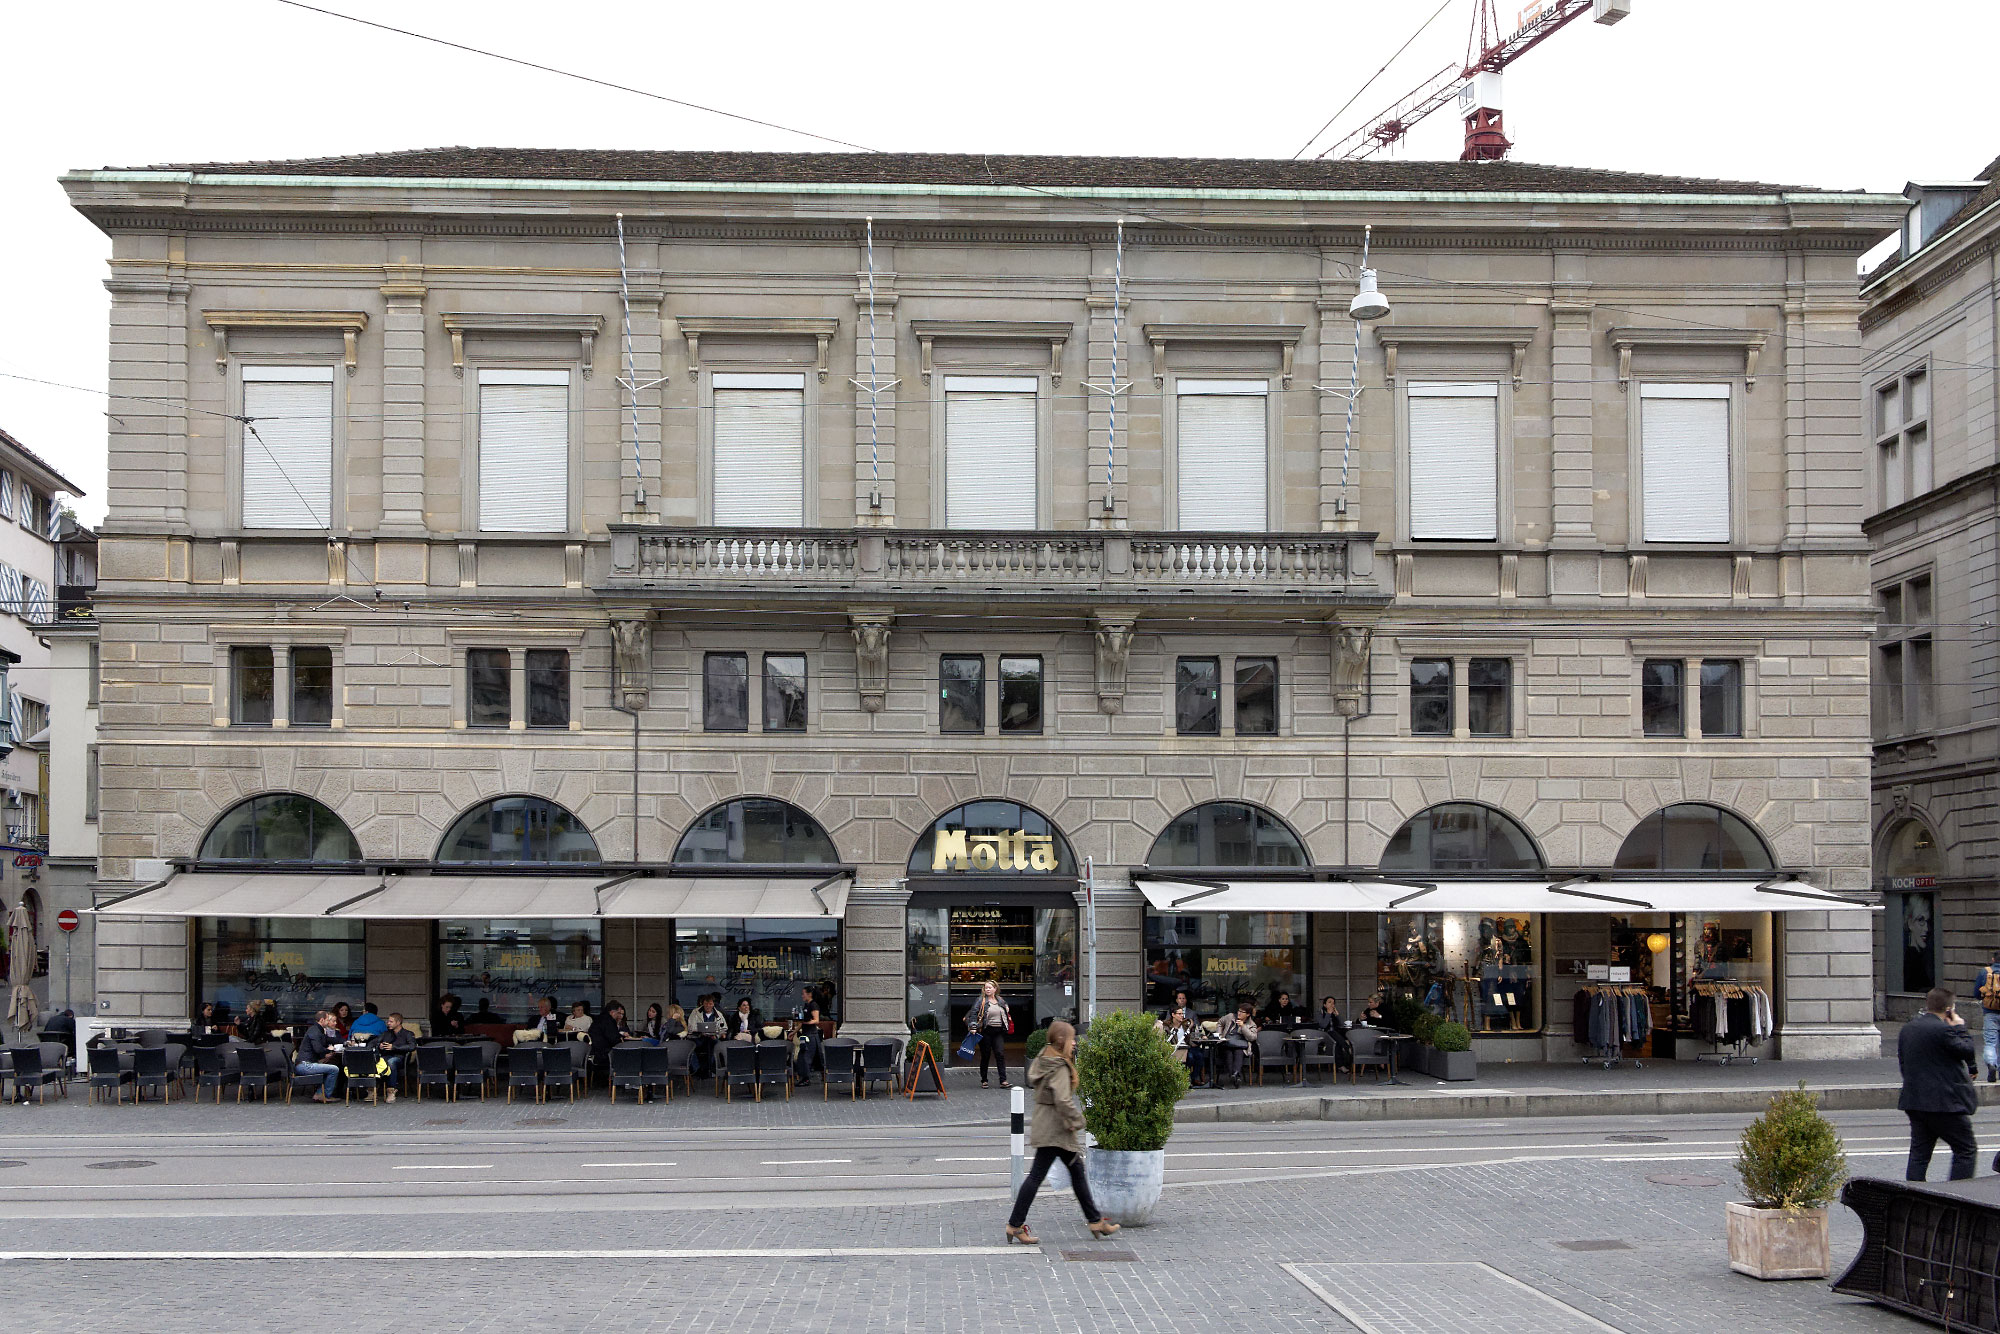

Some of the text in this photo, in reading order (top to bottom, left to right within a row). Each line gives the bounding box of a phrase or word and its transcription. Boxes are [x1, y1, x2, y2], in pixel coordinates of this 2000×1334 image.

[1508, 6, 1553, 42] LIEBHERR
[931, 829, 1058, 871] Motta
[15, 855, 43, 867] OPEN
[1892, 877, 1936, 889] KOCH OPTIK
[263, 952, 304, 965] Motta
[500, 953, 542, 967] Motta
[736, 955, 778, 968] Motta
[1206, 957, 1247, 971] Motta
[720, 978, 754, 995] Gran
